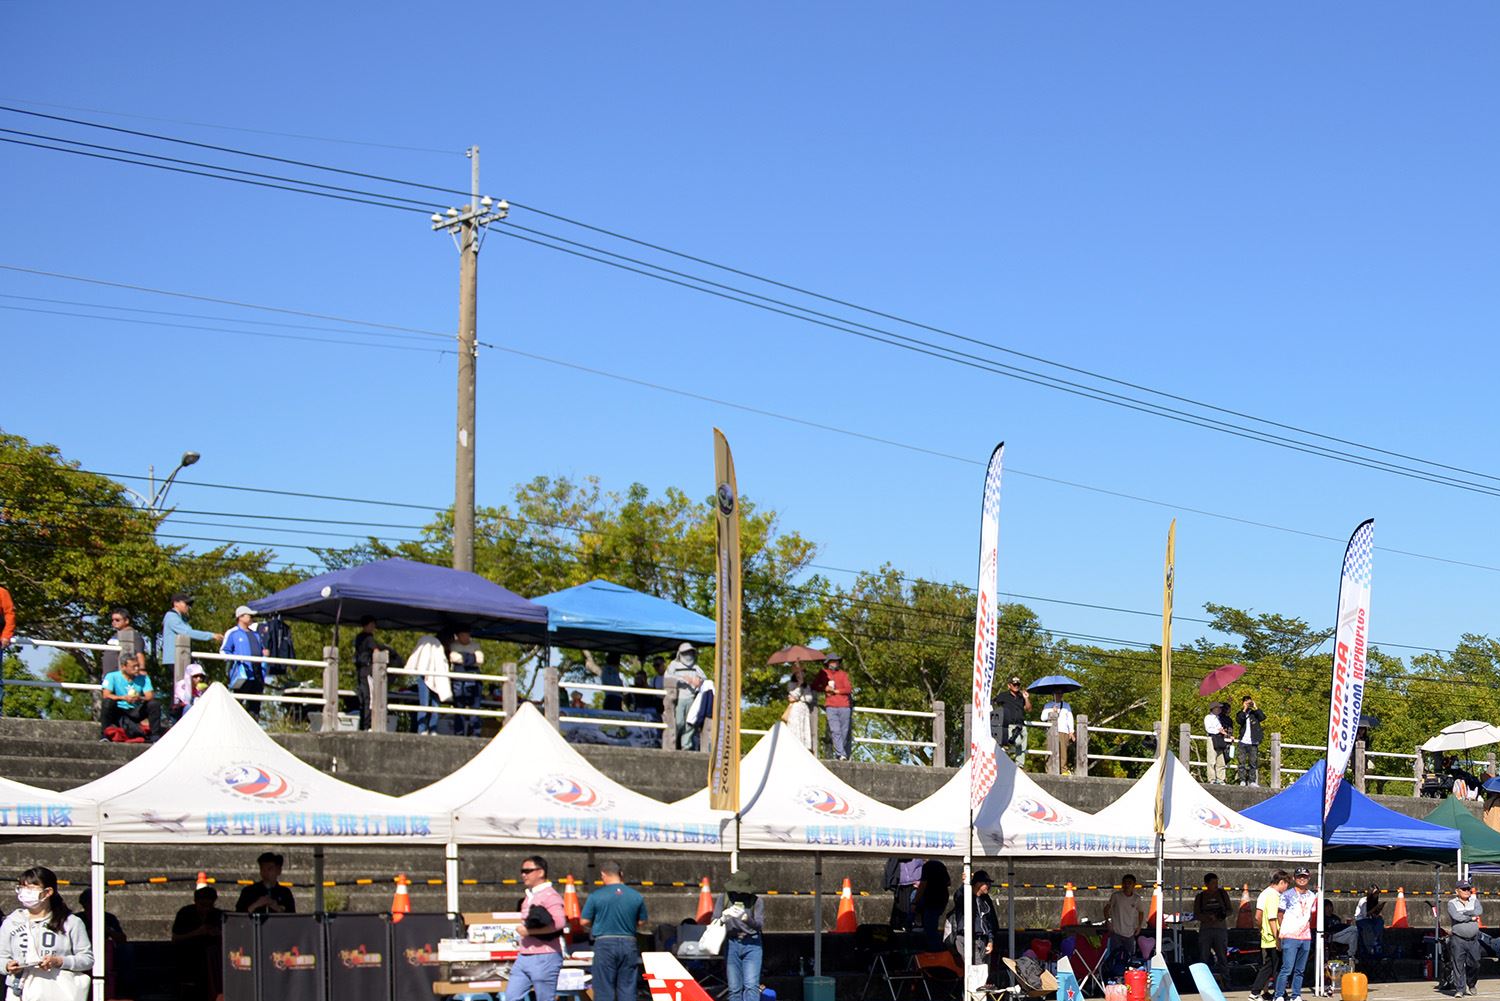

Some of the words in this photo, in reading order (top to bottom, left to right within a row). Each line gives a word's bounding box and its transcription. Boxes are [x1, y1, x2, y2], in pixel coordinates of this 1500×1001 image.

[1353, 607, 1366, 680] RCPROPLUS
[1331, 641, 1349, 749] SUPRA
[206, 812, 432, 836] 模型噴射機飛行團隊
[537, 816, 722, 844] 模型噴射機飛行團隊
